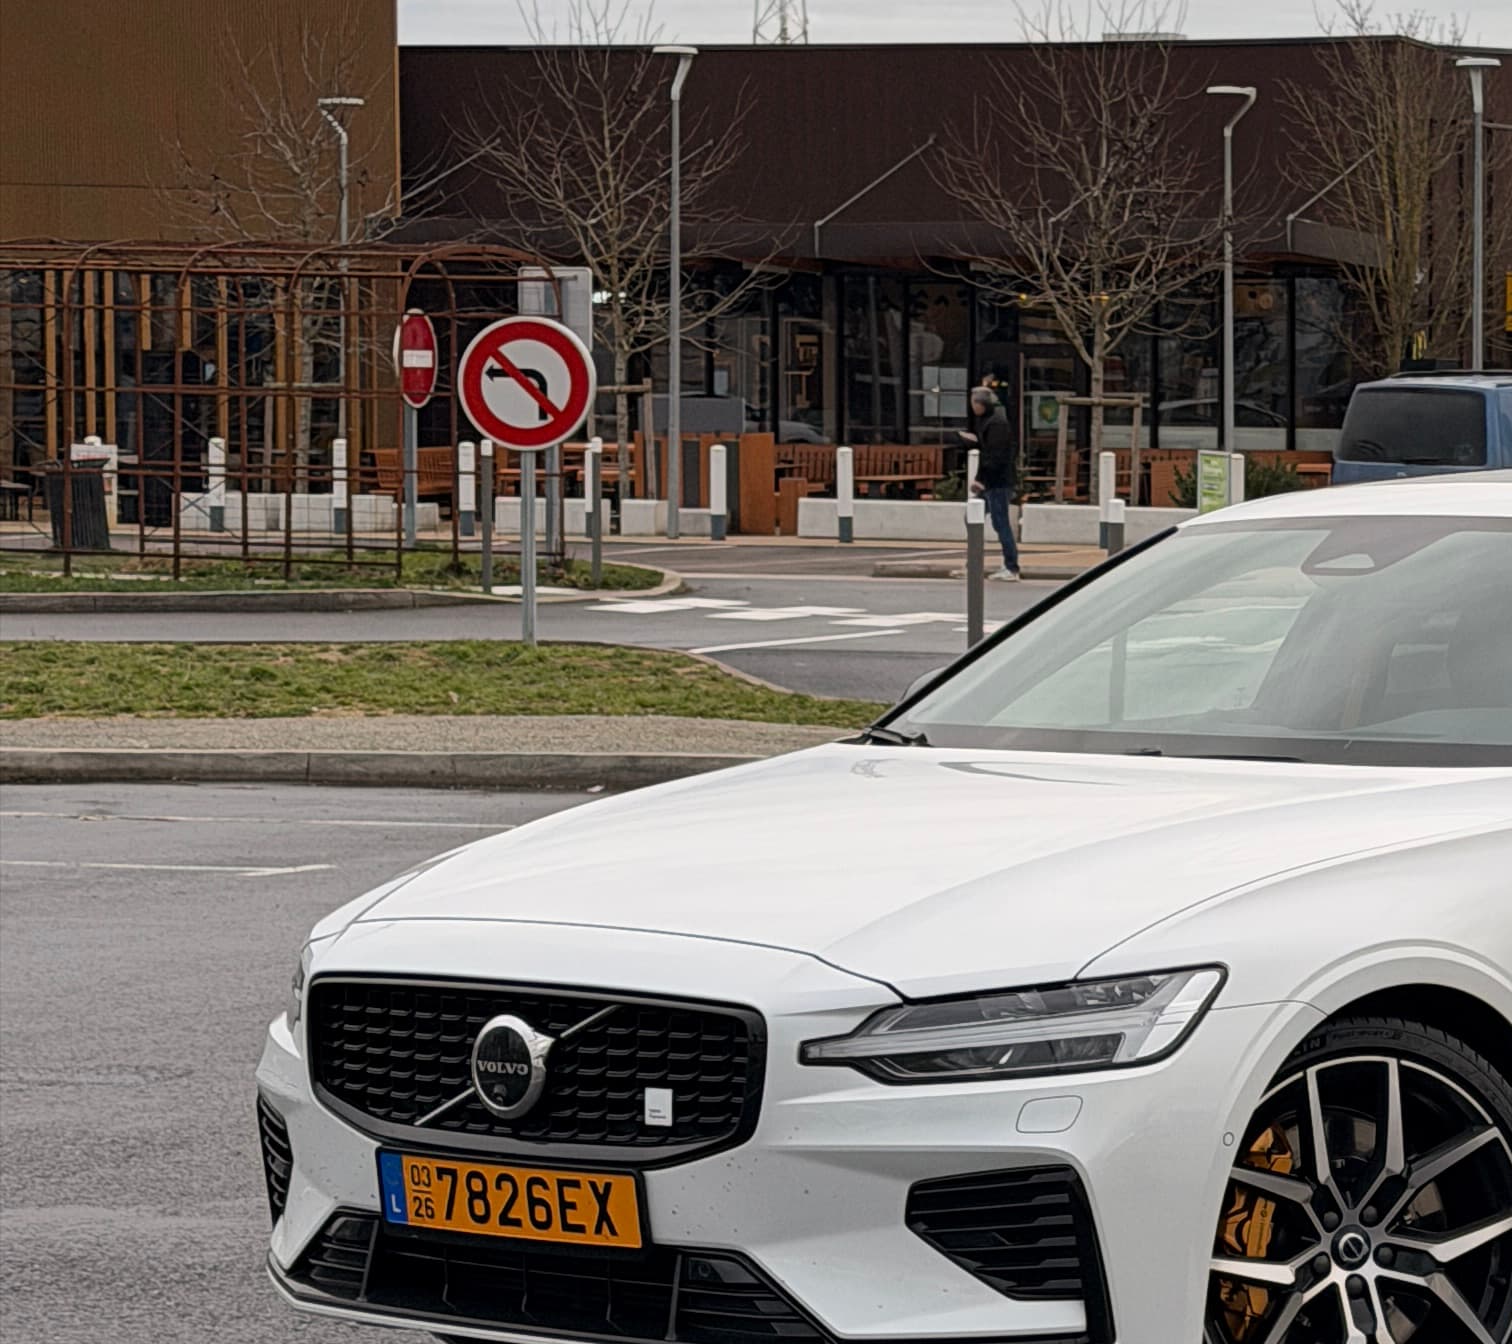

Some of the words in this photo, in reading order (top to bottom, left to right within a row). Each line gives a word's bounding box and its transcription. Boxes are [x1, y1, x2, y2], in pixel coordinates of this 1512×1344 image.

[477, 1060, 529, 1076] VOLVO
[410, 1164, 431, 1188] 03
[391, 1193, 402, 1213] L
[413, 1196, 435, 1220] 26
[436, 1166, 619, 1237] 7826EX
